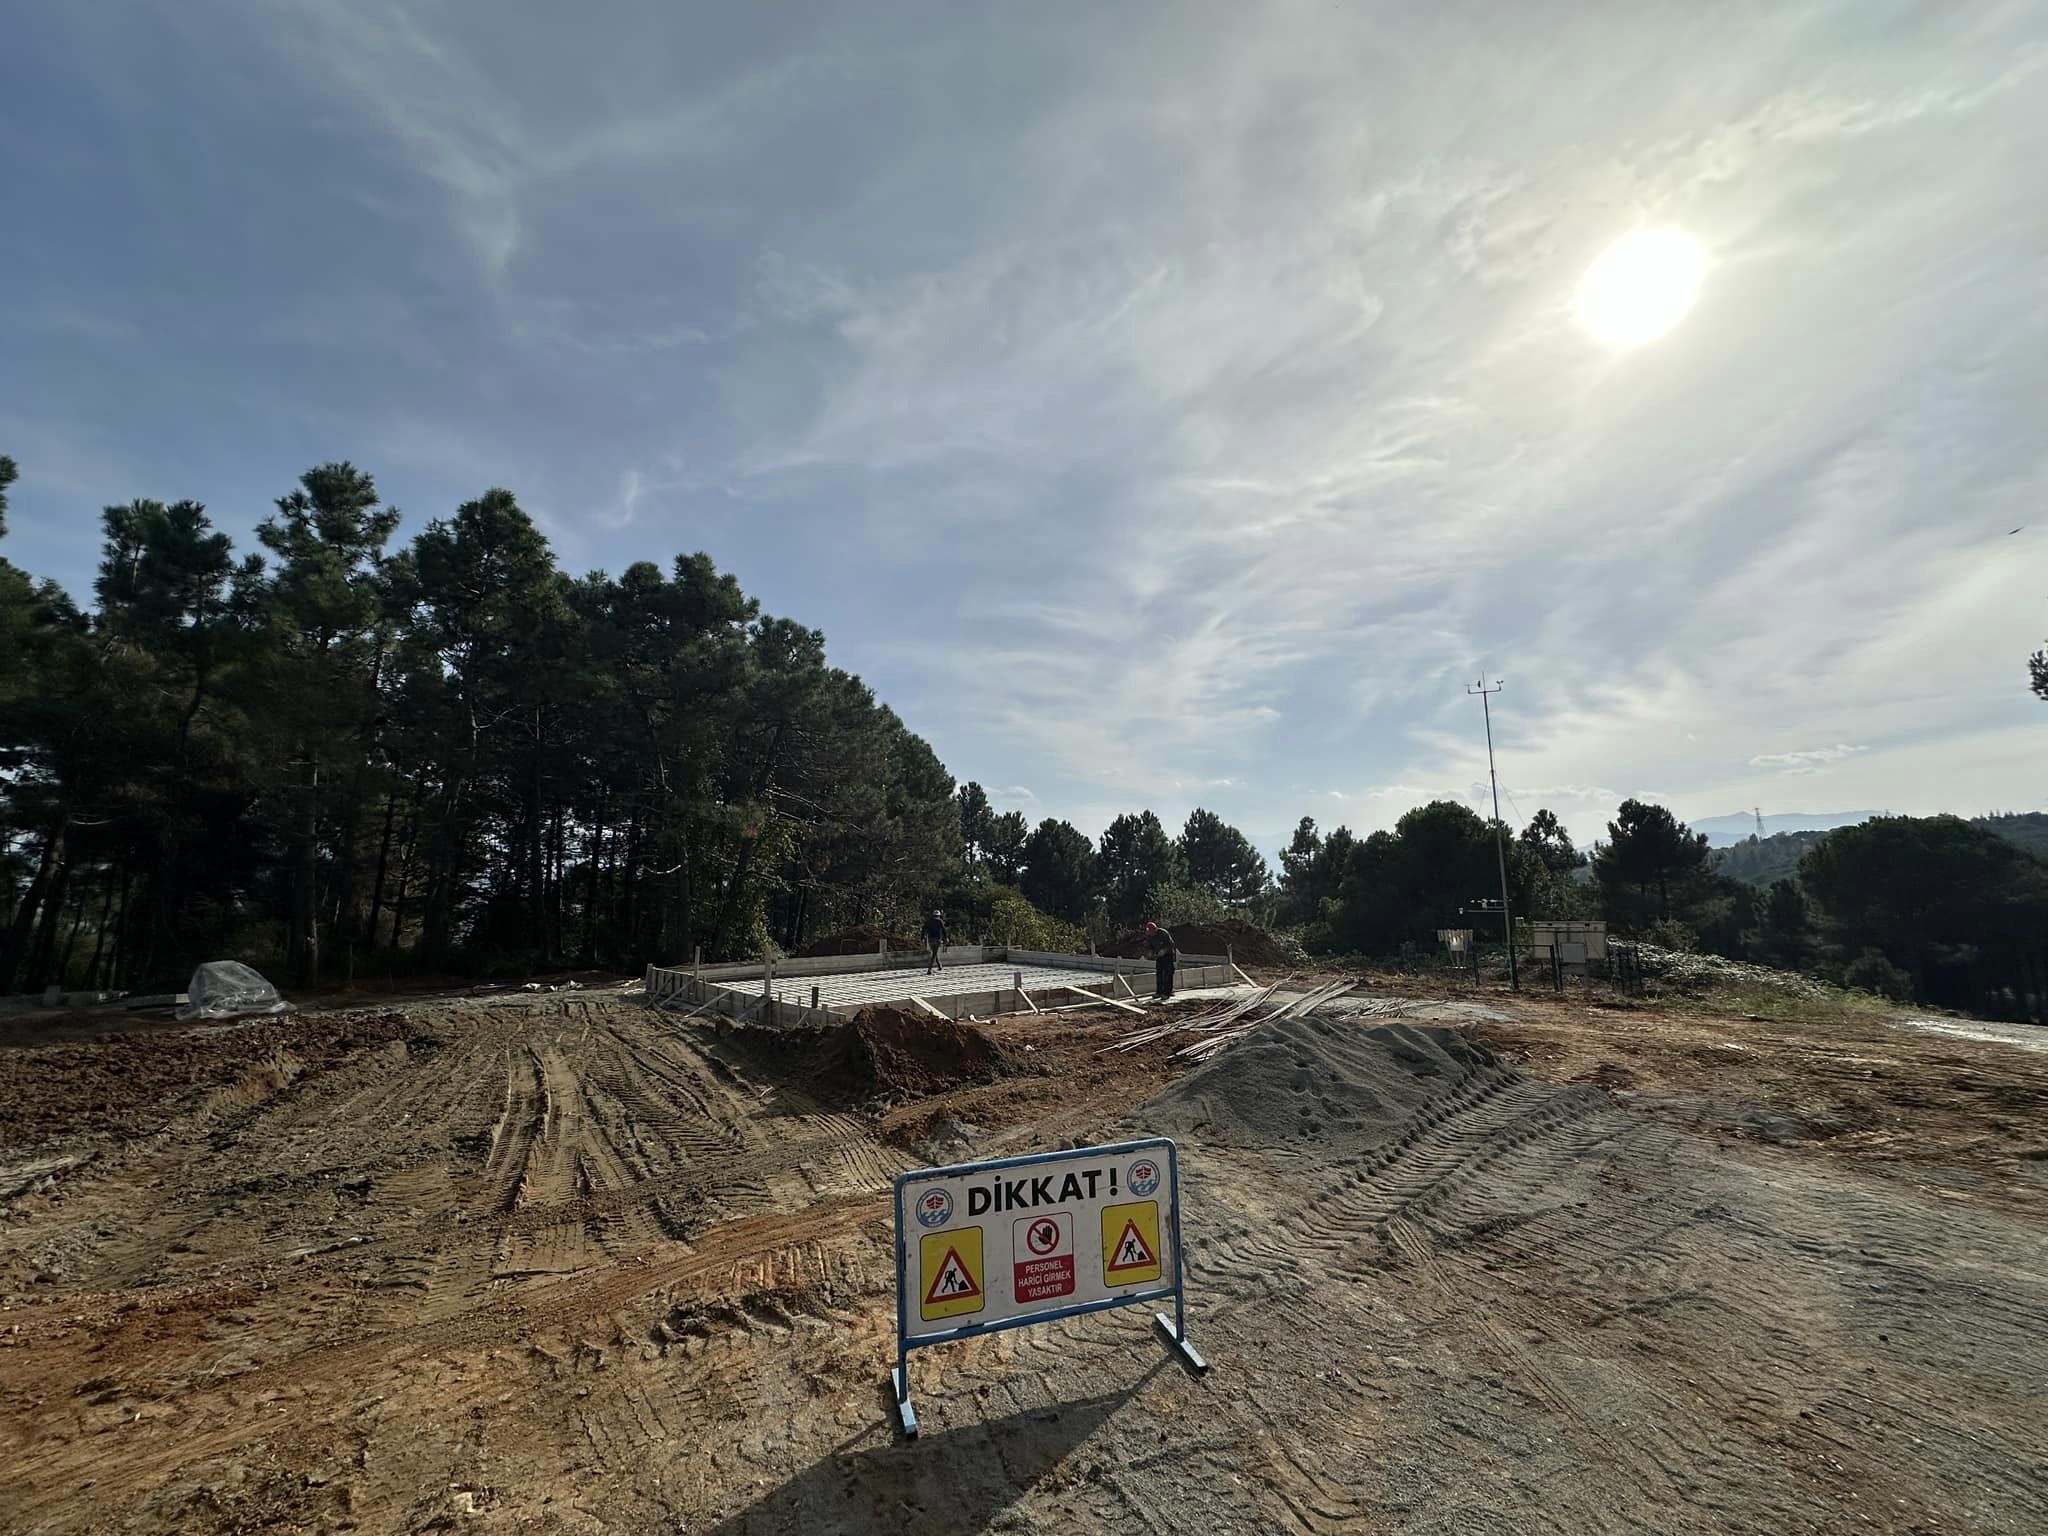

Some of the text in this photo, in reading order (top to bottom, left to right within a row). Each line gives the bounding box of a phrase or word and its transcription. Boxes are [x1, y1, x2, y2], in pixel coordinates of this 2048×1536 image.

[968, 1168, 1117, 1217] DİKKAT!
[1025, 1260, 1063, 1274] PERSONEL
[1043, 1270, 1071, 1283] GİRMEK
[1028, 1283, 1062, 1297] YASAKTIR
